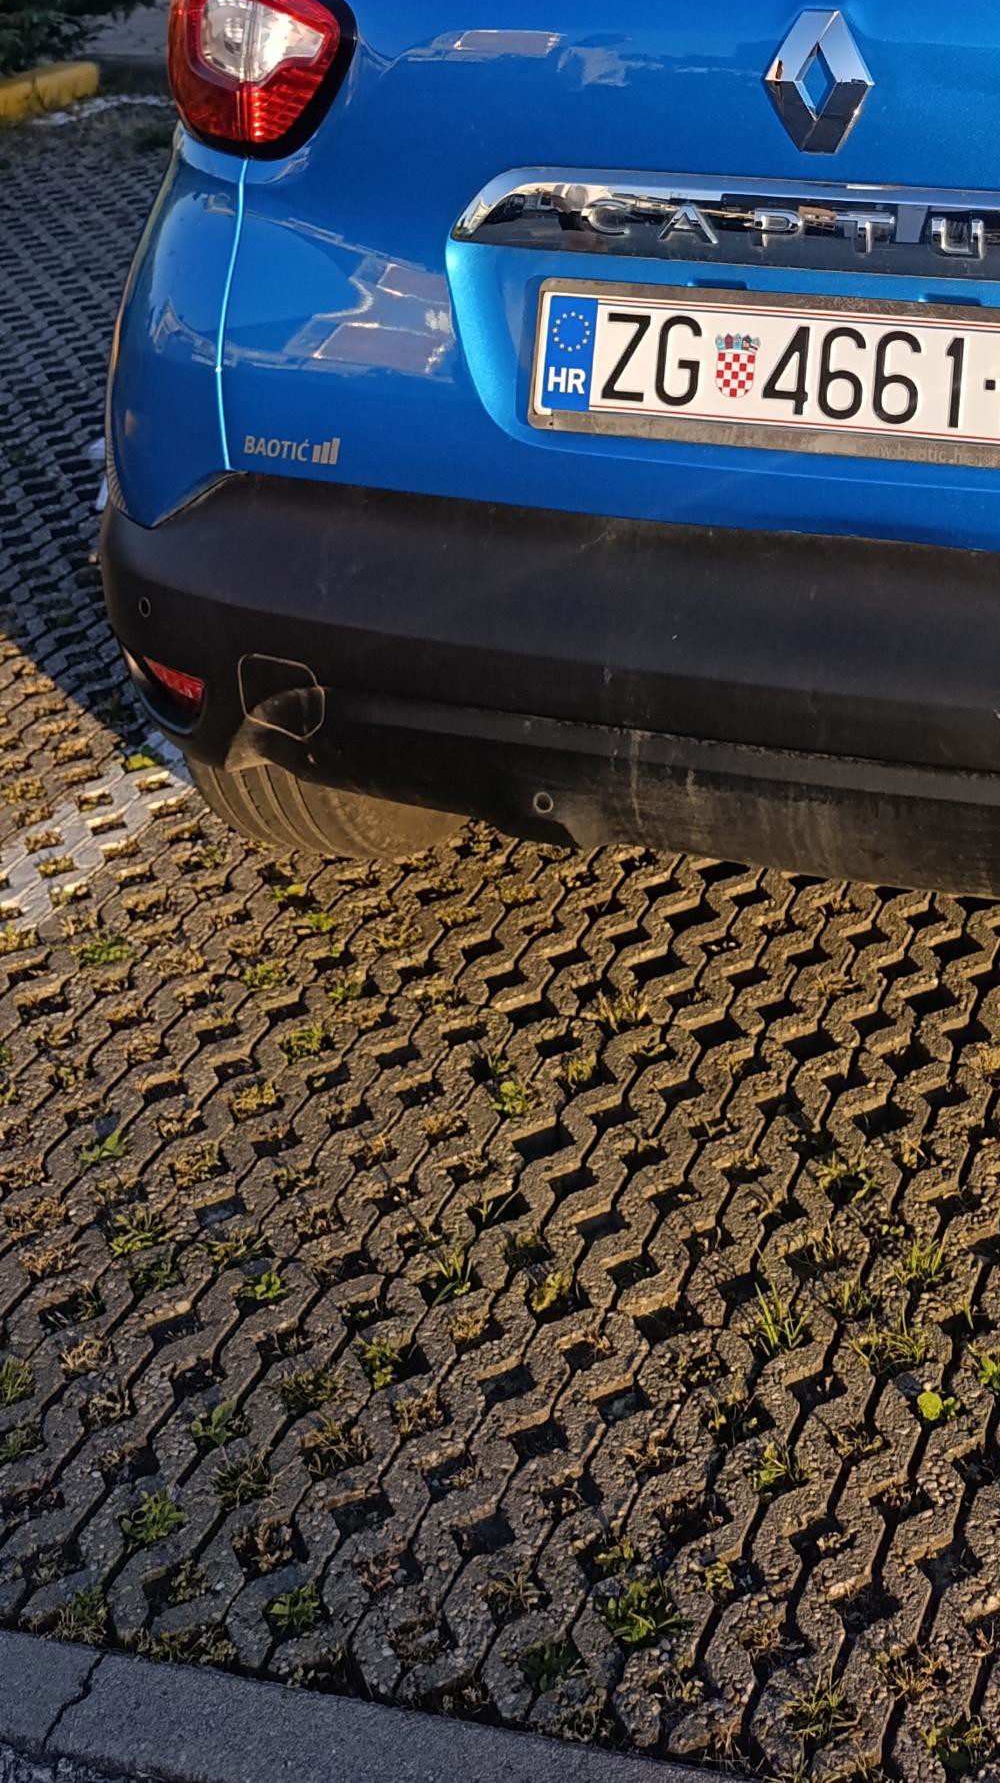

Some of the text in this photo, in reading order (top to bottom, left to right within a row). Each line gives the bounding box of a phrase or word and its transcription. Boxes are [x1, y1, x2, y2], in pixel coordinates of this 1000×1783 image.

[601, 311, 702, 407] ZG
[547, 366, 585, 395] HR
[244, 435, 309, 462] BAOTIĆ
